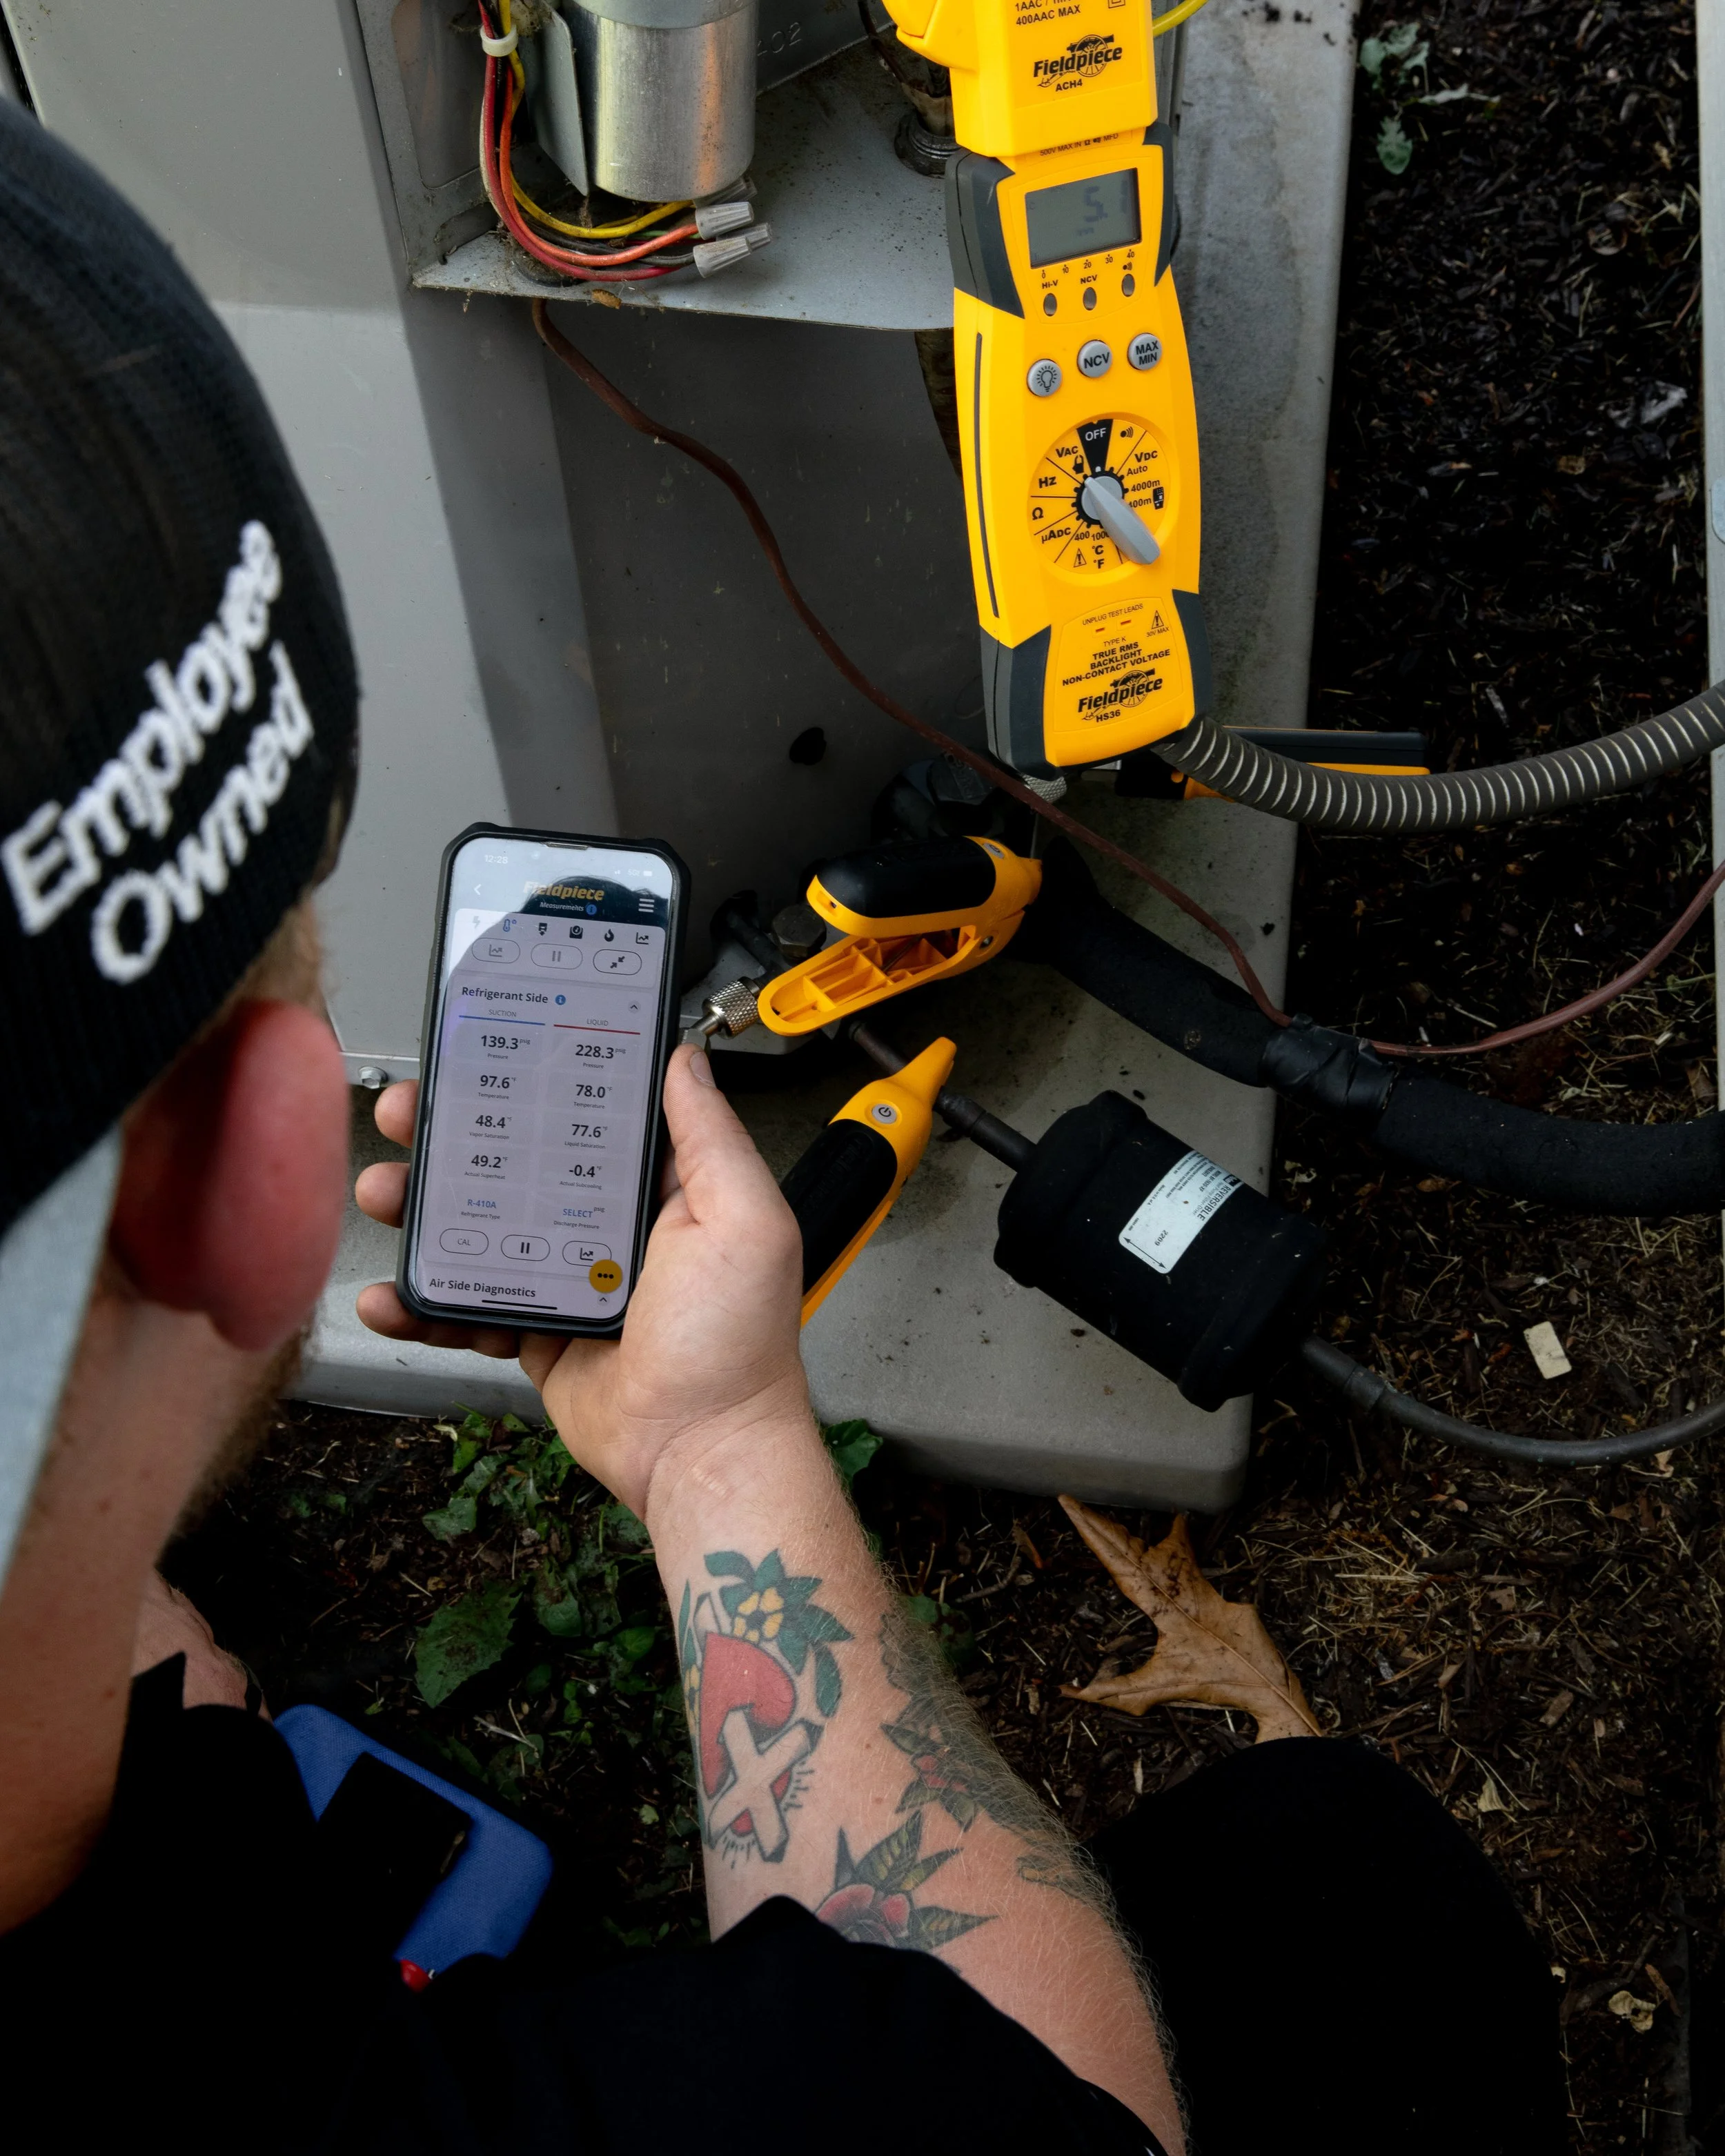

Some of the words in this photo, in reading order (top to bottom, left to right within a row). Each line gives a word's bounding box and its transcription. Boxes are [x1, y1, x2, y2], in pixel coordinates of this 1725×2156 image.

[1016, 10, 1055, 25] 400AAC
[1058, 5, 1081, 17] MAX
[1034, 46, 1123, 77] Fieldpiece
[1056, 79, 1083, 91] ACH4
[1040, 148, 1056, 156] 500V
[1058, 144, 1072, 152] MAX
[1041, 280, 1058, 289] Hi-V
[1081, 275, 1097, 284] NCV
[1136, 340, 1159, 355] MAX
[1084, 352, 1110, 368] NCV
[1139, 352, 1157, 365] MIN
[1085, 428, 1107, 441] OFF
[1126, 465, 1148, 477] Auto
[1038, 476, 1057, 488] Hz
[1131, 479, 1160, 492] 4000m
[1074, 531, 1090, 541] 400
[1083, 613, 1107, 625] UNPLUG
[1108, 609, 1123, 617] TEST
[1125, 603, 1143, 613] LEADS
[1104, 637, 1120, 647] TYPE
[1092, 648, 1116, 660] TRUE
[1120, 642, 1138, 653] RMS
[1090, 649, 1142, 670] BACKLIGHT
[1063, 662, 1127, 686] NON-CONTACT
[1130, 649, 1170, 666] VOLTAGE
[1078, 678, 1163, 713] Fieldpiece
[1096, 709, 1121, 722] HS36
[1, 519, 282, 934] Employee
[90, 641, 315, 985] Owned
[484, 855, 509, 864] 12:28
[523, 881, 604, 901] Fieldpiece
[540, 902, 584, 911] Measurements
[462, 987, 523, 1000] Refrigerant
[525, 993, 549, 1003] Side
[481, 1035, 518, 1049] 139.3
[575, 1044, 614, 1058] 228.3
[480, 1075, 510, 1089] 97.6
[576, 1084, 605, 1098] 78.0
[475, 1115, 506, 1128] 48.4
[572, 1124, 601, 1138] 77.6
[471, 1155, 502, 1168] 49.2
[569, 1165, 595, 1177] -0.4
[467, 1199, 496, 1208] R-410A
[1196, 1185, 1231, 1221] REVERSIBLE
[563, 1208, 593, 1218] SELECT
[457, 1238, 471, 1246] CAL
[1154, 1229, 1168, 1246] 2209
[429, 1278, 445, 1288] Air
[448, 1280, 471, 1291] Side
[473, 1283, 535, 1298] Diagnostics
